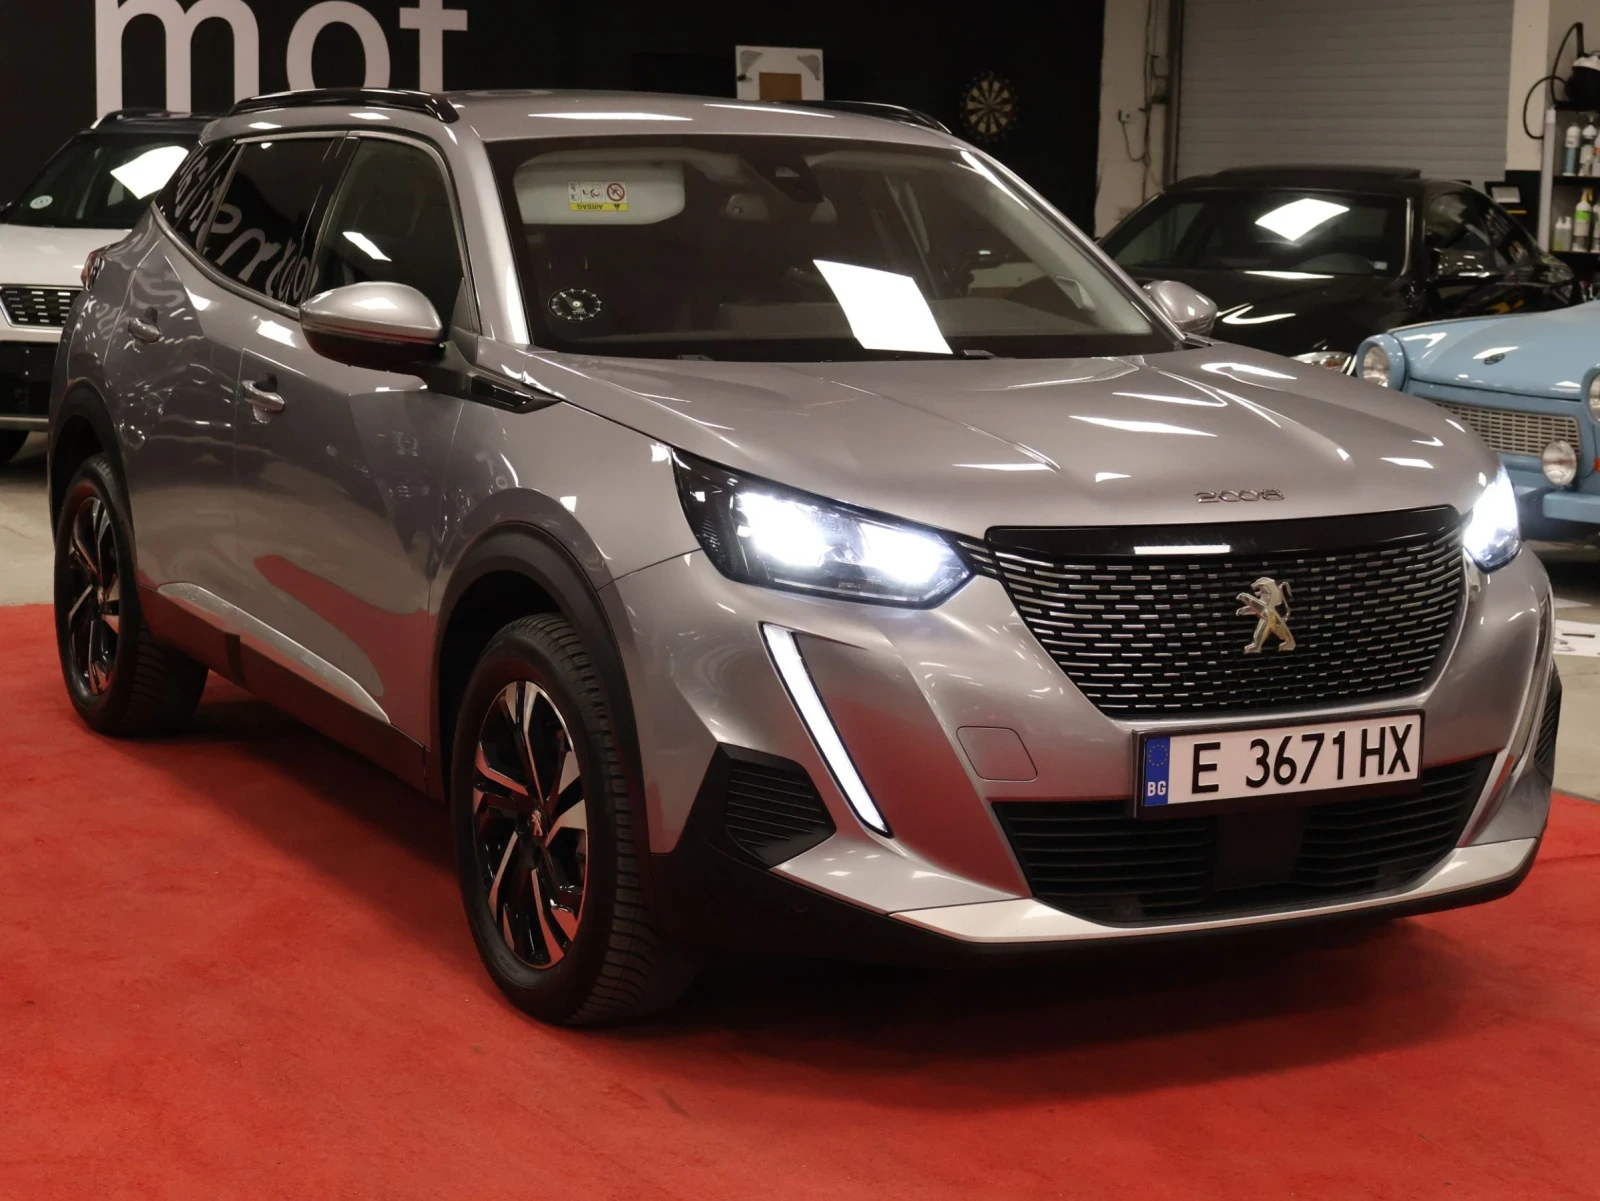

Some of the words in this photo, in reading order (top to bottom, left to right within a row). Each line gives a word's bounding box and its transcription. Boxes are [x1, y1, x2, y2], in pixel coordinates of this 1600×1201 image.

[1194, 489, 1284, 503] 2008
[1191, 741, 1221, 794] E
[1245, 730, 1346, 788] 3671
[1359, 723, 1412, 777] HX
[1147, 780, 1167, 797] BG
